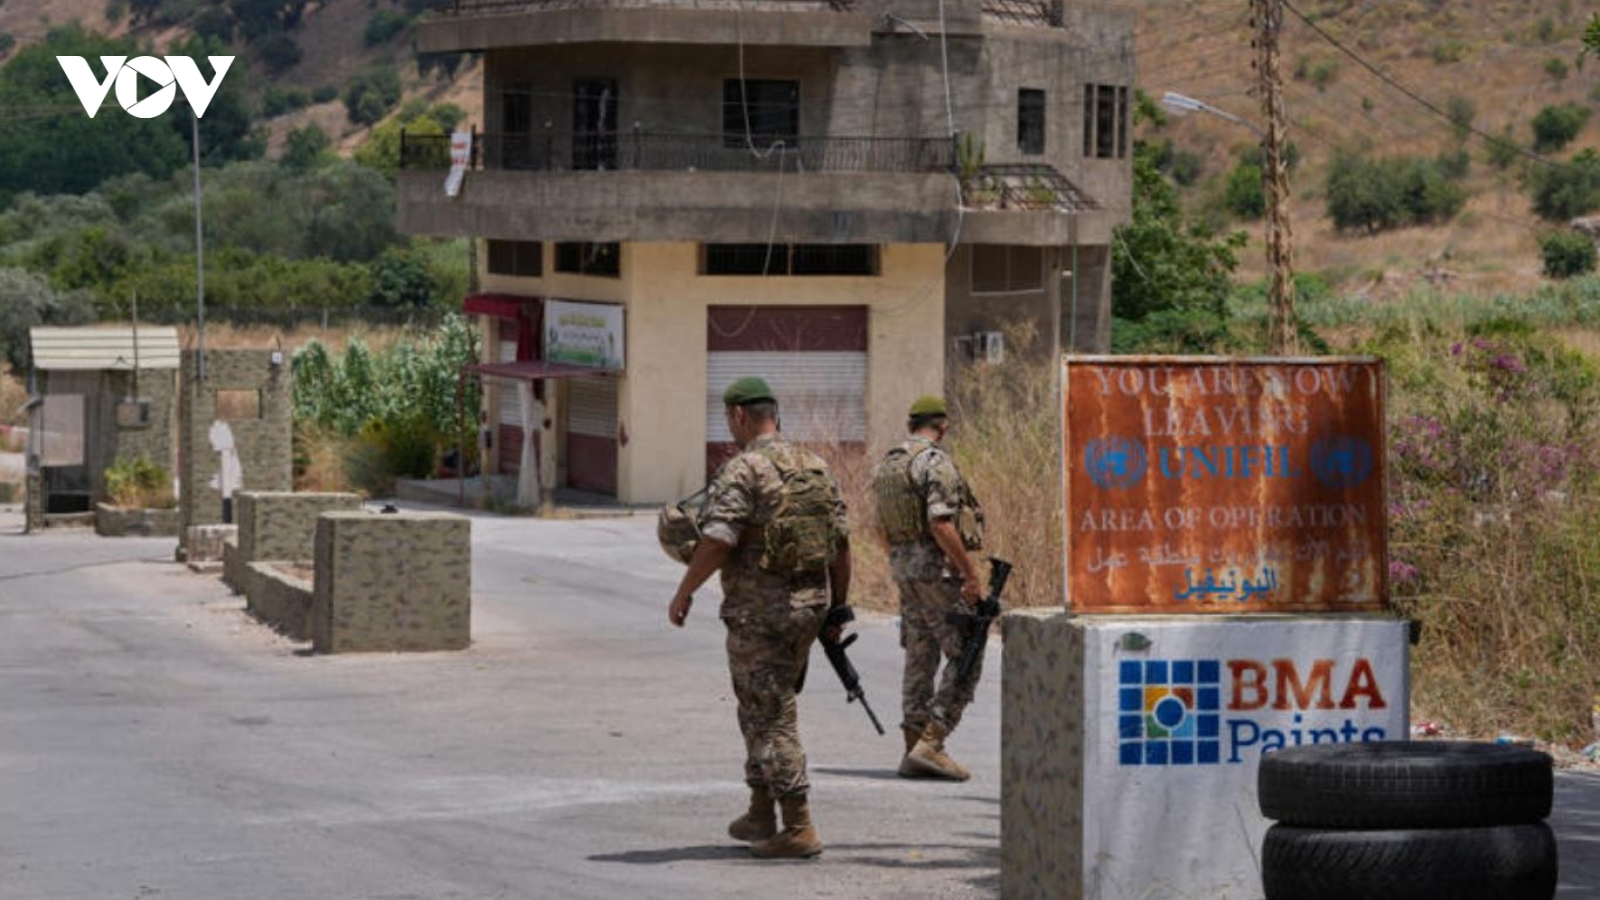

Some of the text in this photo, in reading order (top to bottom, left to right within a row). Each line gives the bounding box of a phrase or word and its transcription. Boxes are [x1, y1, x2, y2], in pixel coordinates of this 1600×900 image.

[1093, 365, 1361, 396] YOU ARE NOW
[1142, 404, 1311, 437] LEAVING
[1158, 446, 1303, 479] UNIFIL
[1080, 504, 1368, 533] AREA OF OPERATION
[1173, 566, 1277, 601] اليونيفيل
[1226, 658, 1387, 711] BMA
